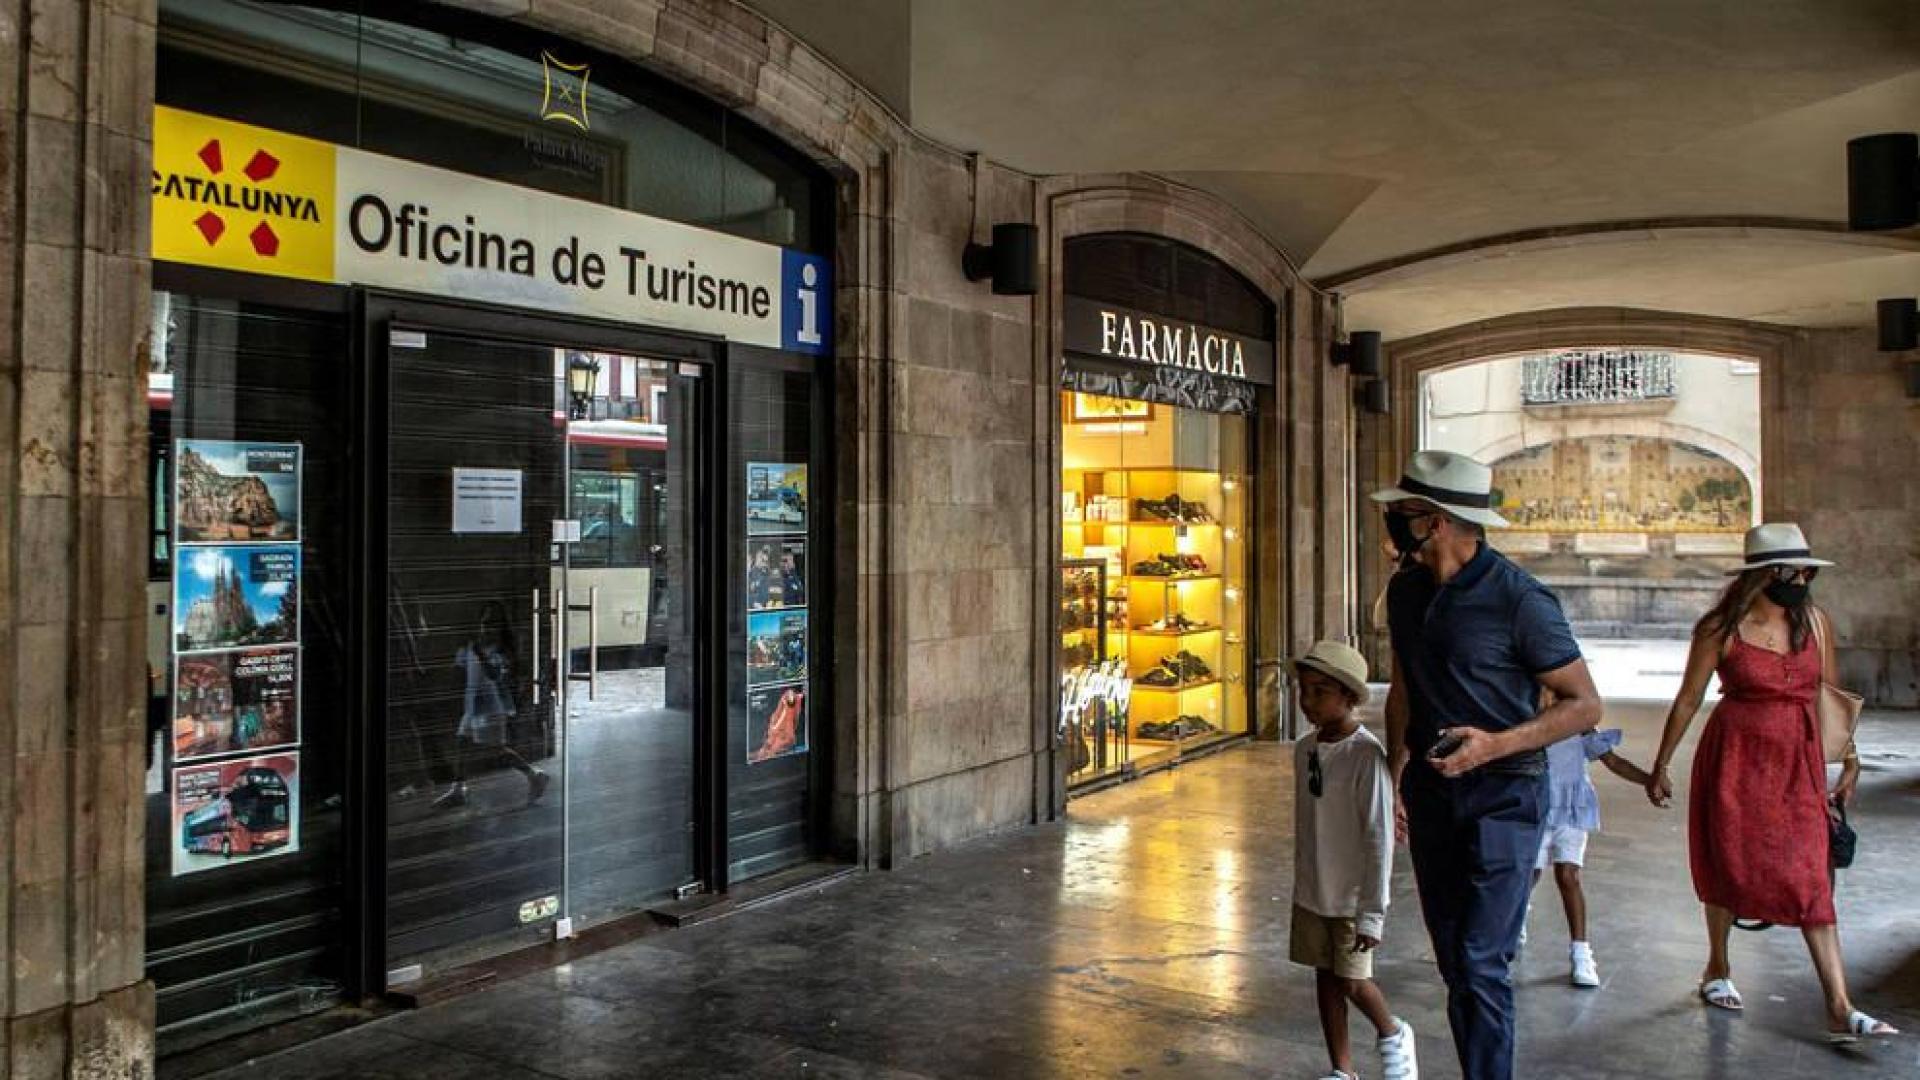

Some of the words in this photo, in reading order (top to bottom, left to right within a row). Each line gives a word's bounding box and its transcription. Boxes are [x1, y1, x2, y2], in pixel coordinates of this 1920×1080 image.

[151, 170, 320, 223] CATALUNYA
[350, 194, 535, 278] Oficina
[552, 236, 606, 290] de
[619, 246, 771, 318] Turisme
[1102, 311, 1245, 378] FARMÀCIA
